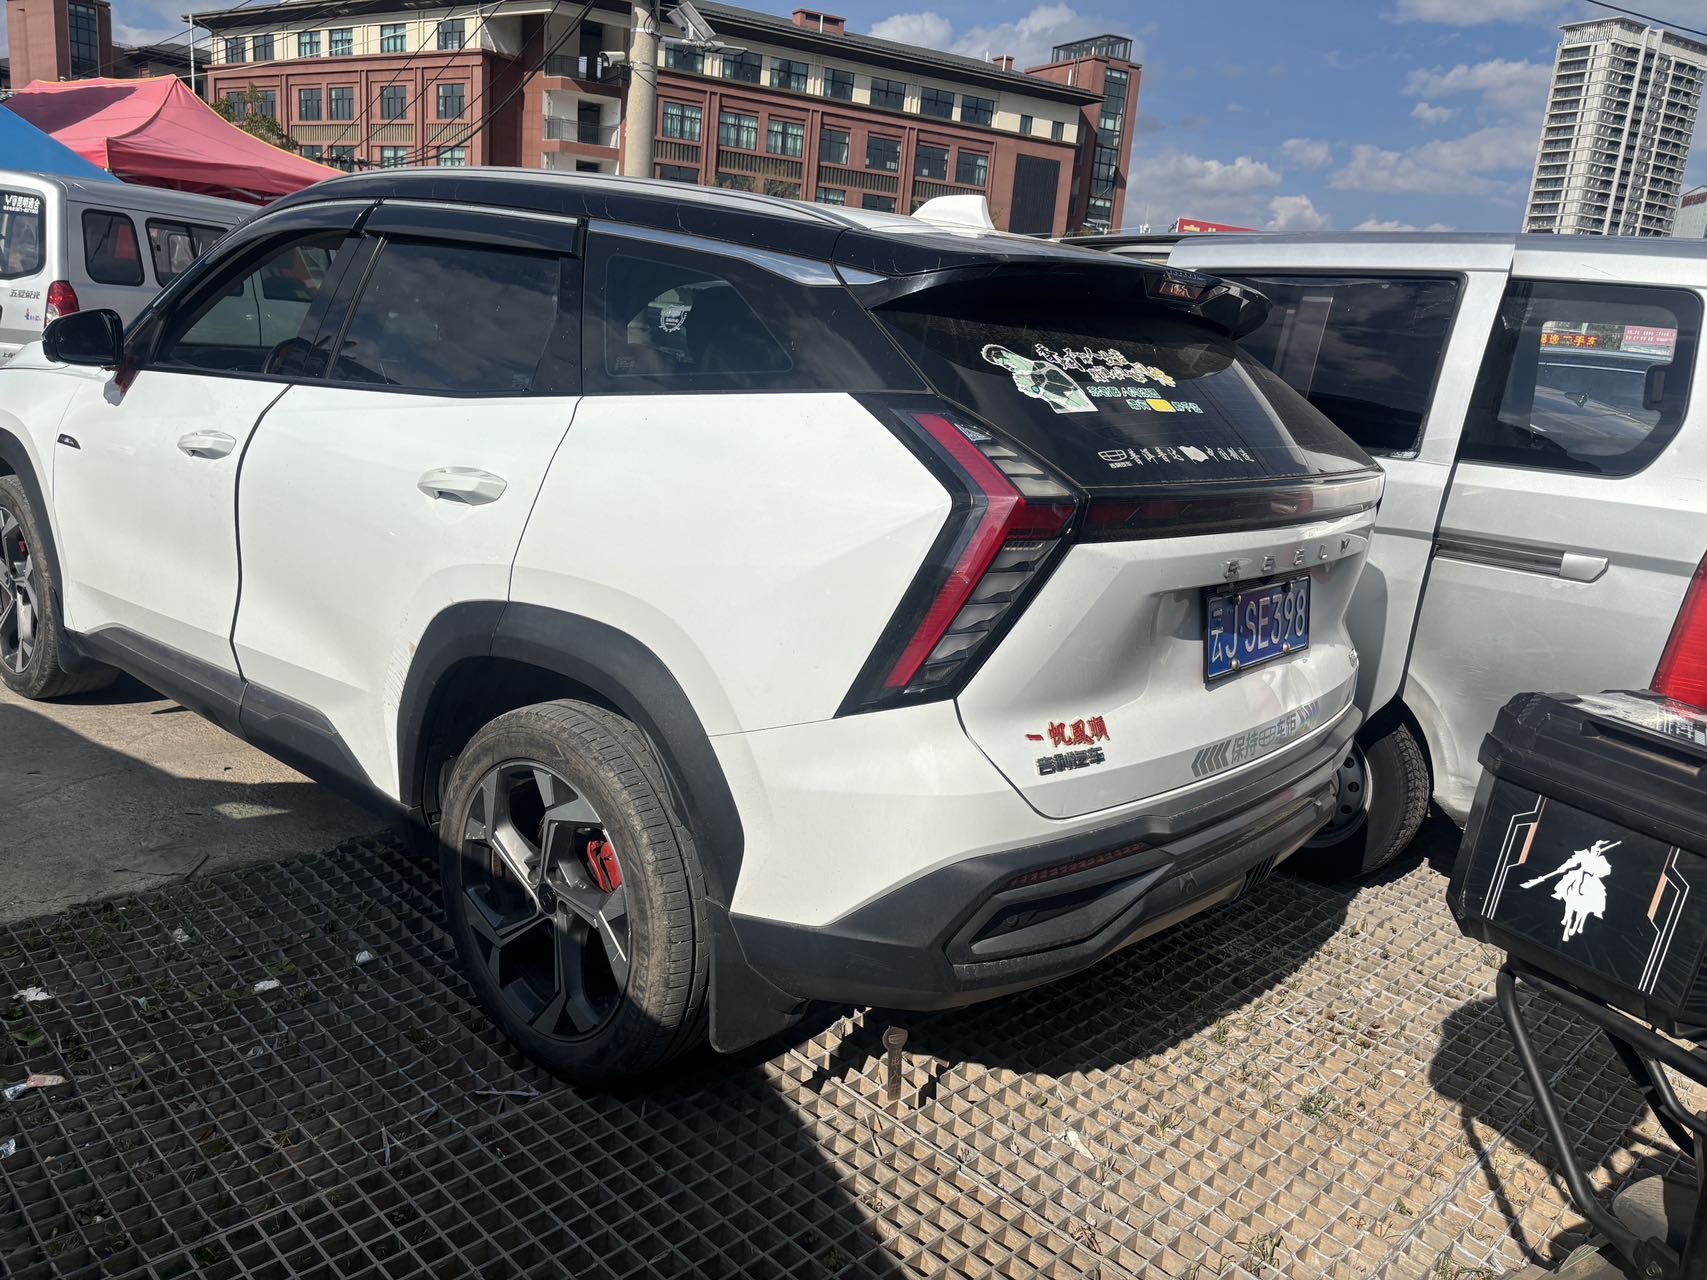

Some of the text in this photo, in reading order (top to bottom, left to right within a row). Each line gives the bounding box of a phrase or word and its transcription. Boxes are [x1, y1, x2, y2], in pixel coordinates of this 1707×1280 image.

[1205, 445, 1255, 463] 中国制造
[1223, 538, 1350, 578] GEELY
[1230, 712, 1297, 764] 保持 车距
[1035, 746, 1106, 776] 吉利汽车
